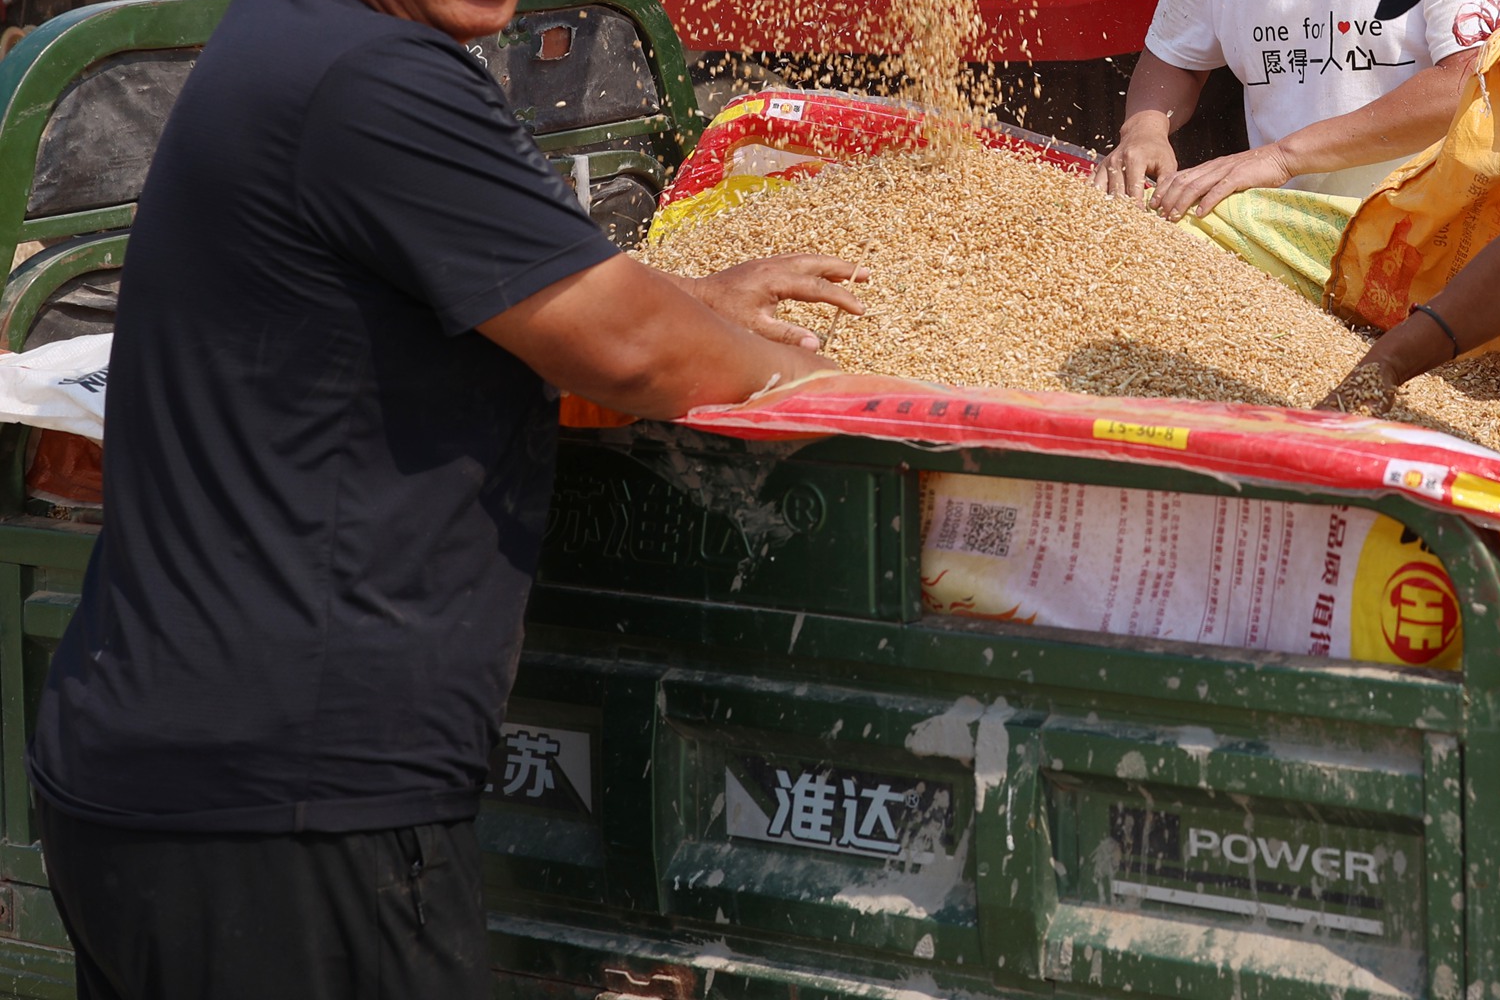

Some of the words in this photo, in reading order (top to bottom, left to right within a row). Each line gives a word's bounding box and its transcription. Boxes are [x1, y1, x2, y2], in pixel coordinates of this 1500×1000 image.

[1253, 25, 1289, 42] one
[1303, 17, 1325, 39] for
[1250, 48, 1414, 86] 愿得一人心
[1320, 504, 1347, 585] 品质
[484, 733, 558, 797] 苏
[768, 769, 904, 853] 淮达
[1189, 828, 1379, 884] POWER
